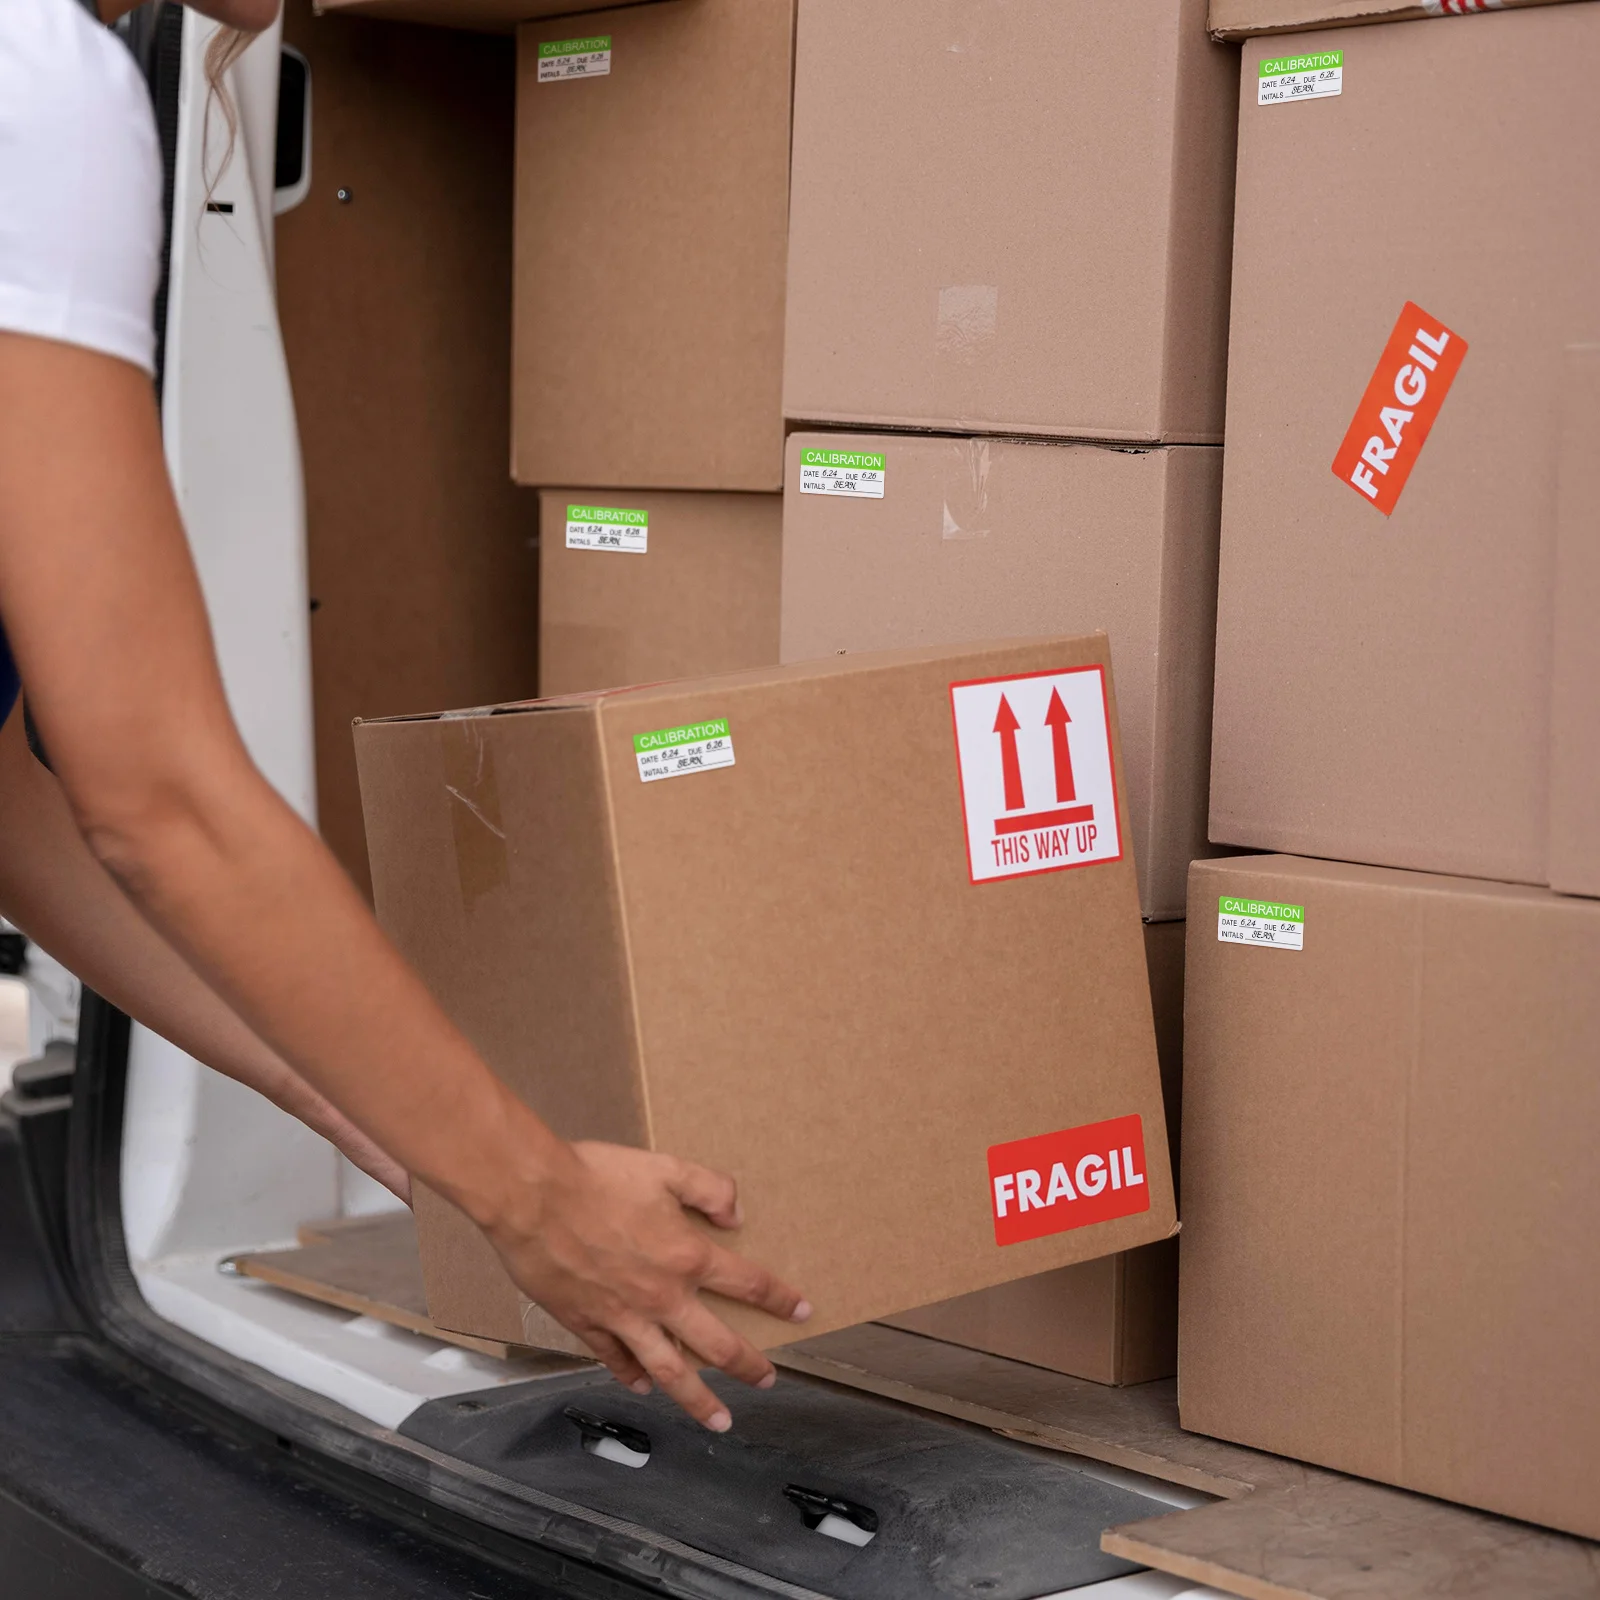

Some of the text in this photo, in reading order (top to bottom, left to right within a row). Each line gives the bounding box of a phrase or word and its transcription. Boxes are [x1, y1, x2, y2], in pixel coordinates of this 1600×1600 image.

[543, 39, 608, 54] CALIBRATION
[1265, 54, 1339, 73] CALIBRATION
[1262, 80, 1277, 88] DATE
[1303, 76, 1316, 84] DUE
[1262, 92, 1283, 100] INITALS
[1350, 328, 1450, 499] FRAGIL
[806, 451, 882, 467] CALIBRATION
[804, 470, 819, 478] DATE
[845, 473, 859, 481] DUE
[803, 482, 826, 490] INITALS
[572, 508, 645, 524] CALIBRATION
[569, 526, 584, 534] DATE
[640, 721, 725, 748] CALIBRATION
[640, 755, 659, 765] DATE
[688, 746, 703, 756] DUE
[643, 766, 669, 777] INITALS
[991, 824, 1097, 867] THIS WAY UP
[1224, 900, 1300, 919] CALIBRATION
[1221, 919, 1237, 927] DATE
[1264, 923, 1277, 932] DUE
[1221, 930, 1244, 939] INITALS
[994, 1146, 1144, 1218] FRAGIL
